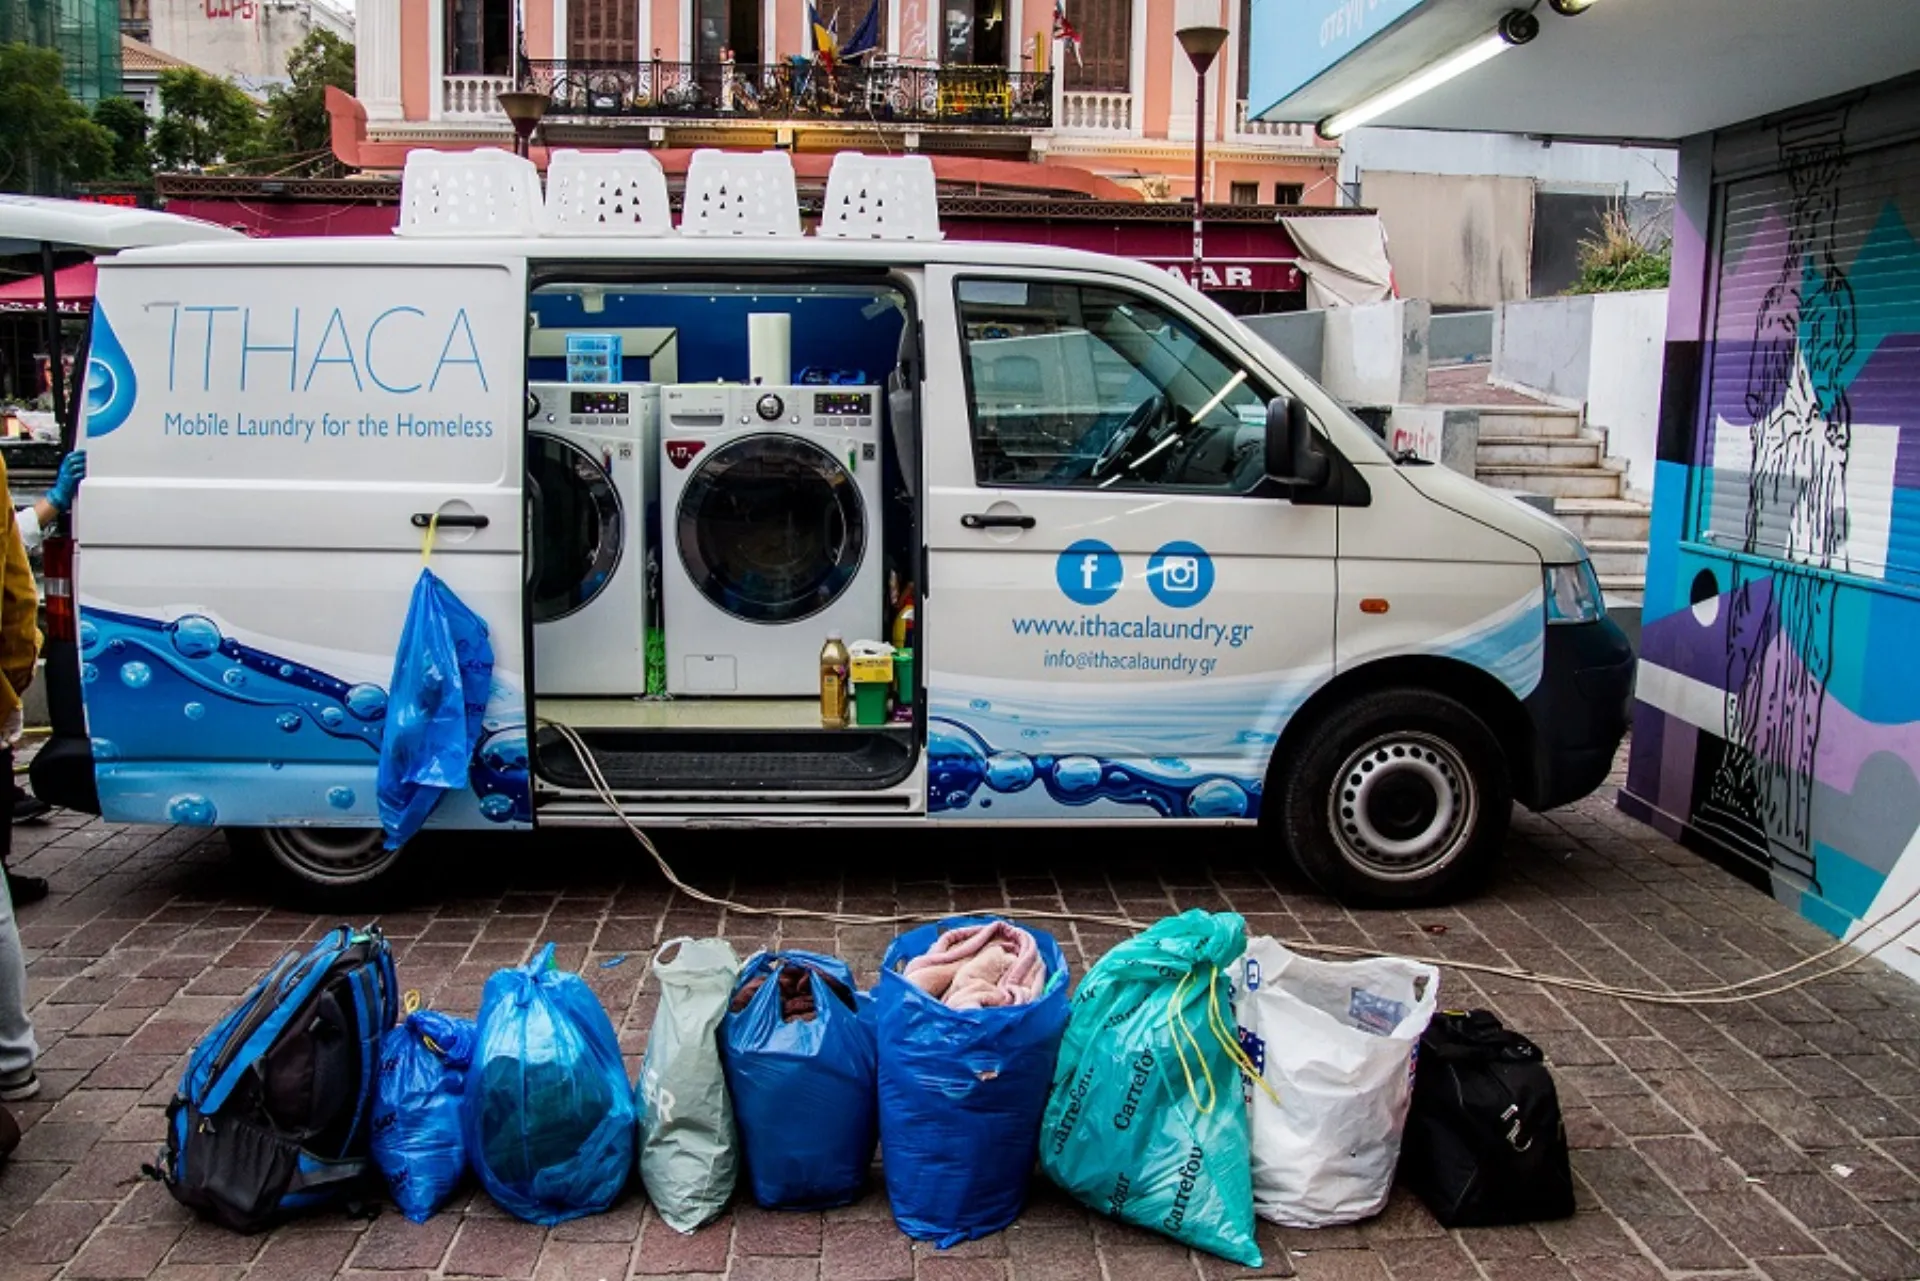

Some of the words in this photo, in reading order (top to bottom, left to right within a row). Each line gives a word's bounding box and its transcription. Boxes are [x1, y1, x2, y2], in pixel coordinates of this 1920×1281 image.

[144, 301, 489, 394] ITHACA
[165, 413, 229, 437] Mobile
[237, 413, 315, 443] Laundry
[322, 413, 350, 437] for
[358, 413, 389, 437] the
[397, 413, 493, 438] Homeless
[1012, 614, 1254, 648] www.ithacalaundry.gr
[1043, 649, 1218, 676] info@ithacalaundrygr
[1163, 1139, 1205, 1234] Carrefou
